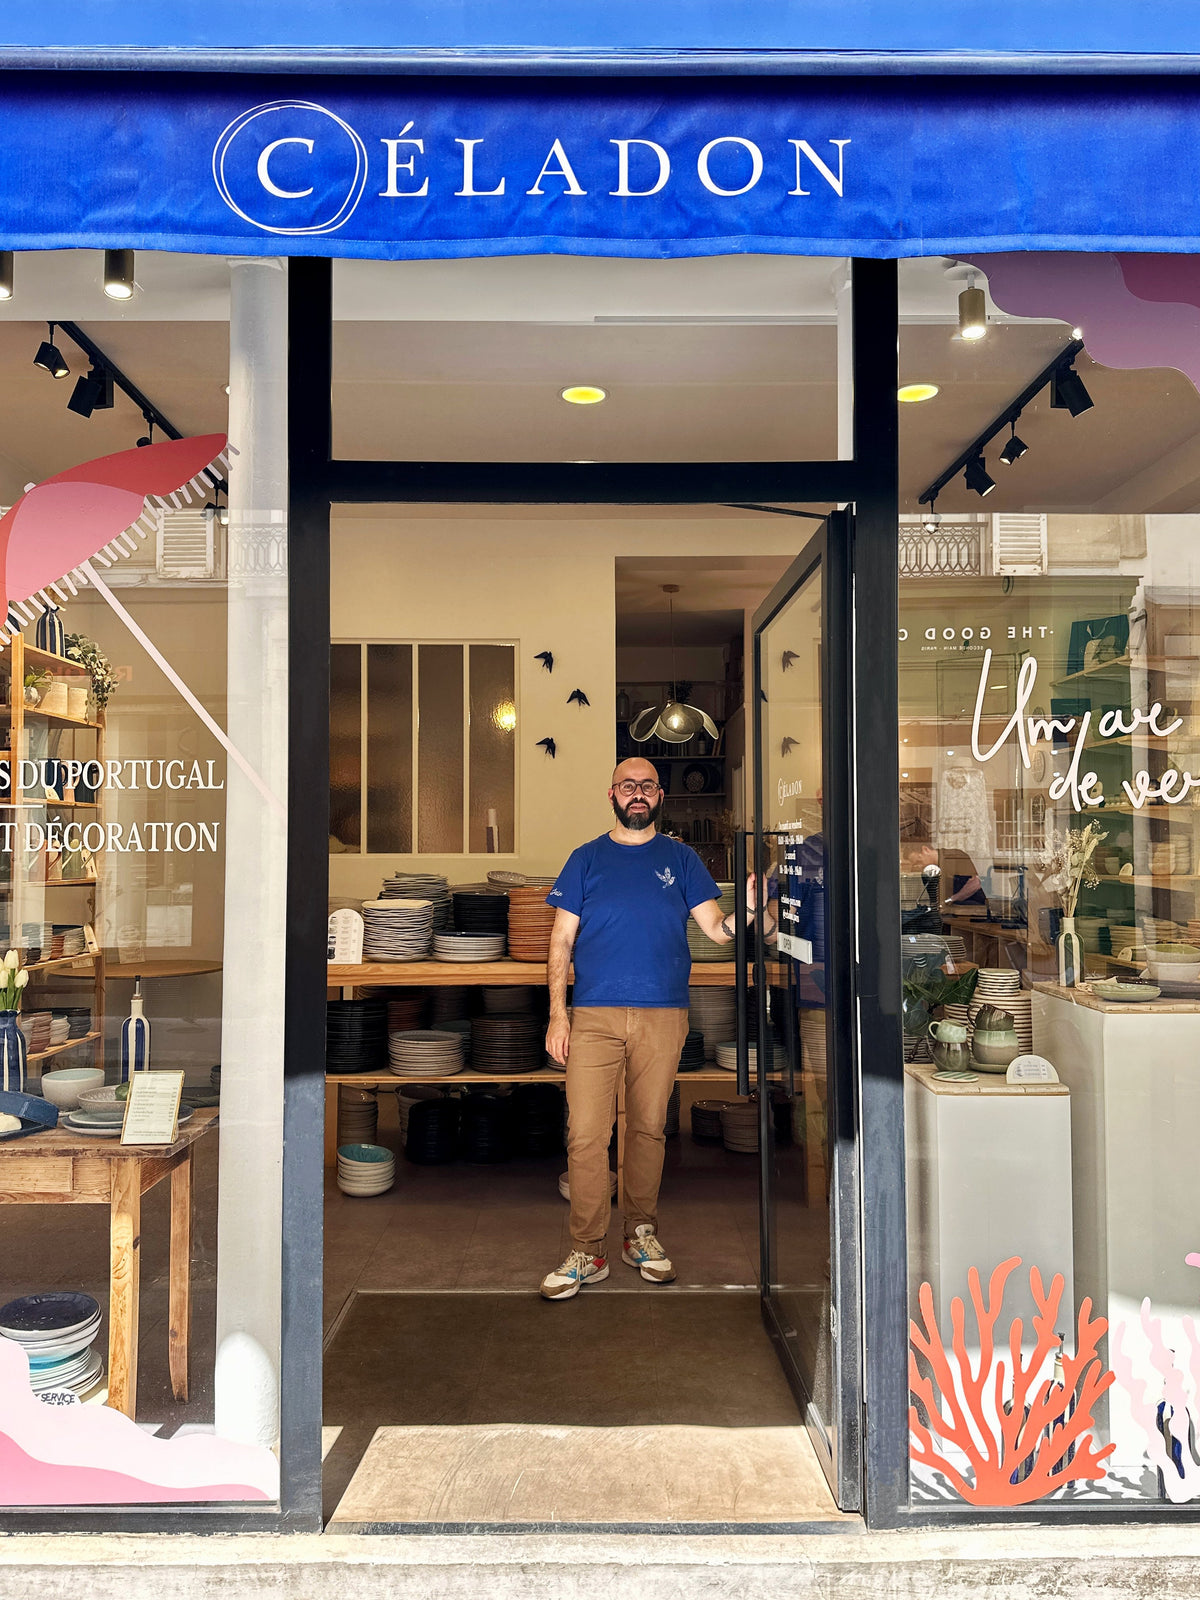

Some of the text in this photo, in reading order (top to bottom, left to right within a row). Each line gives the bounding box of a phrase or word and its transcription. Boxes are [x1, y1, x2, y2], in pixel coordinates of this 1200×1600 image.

[256, 119, 852, 199] CÉLADON
[17, 759, 61, 790] DU
[65, 758, 225, 790] PORTUGAL
[1048, 711, 1105, 813] de
[24, 815, 220, 852] DÉCORATION
[40, 1392, 76, 1404] SERVICE
